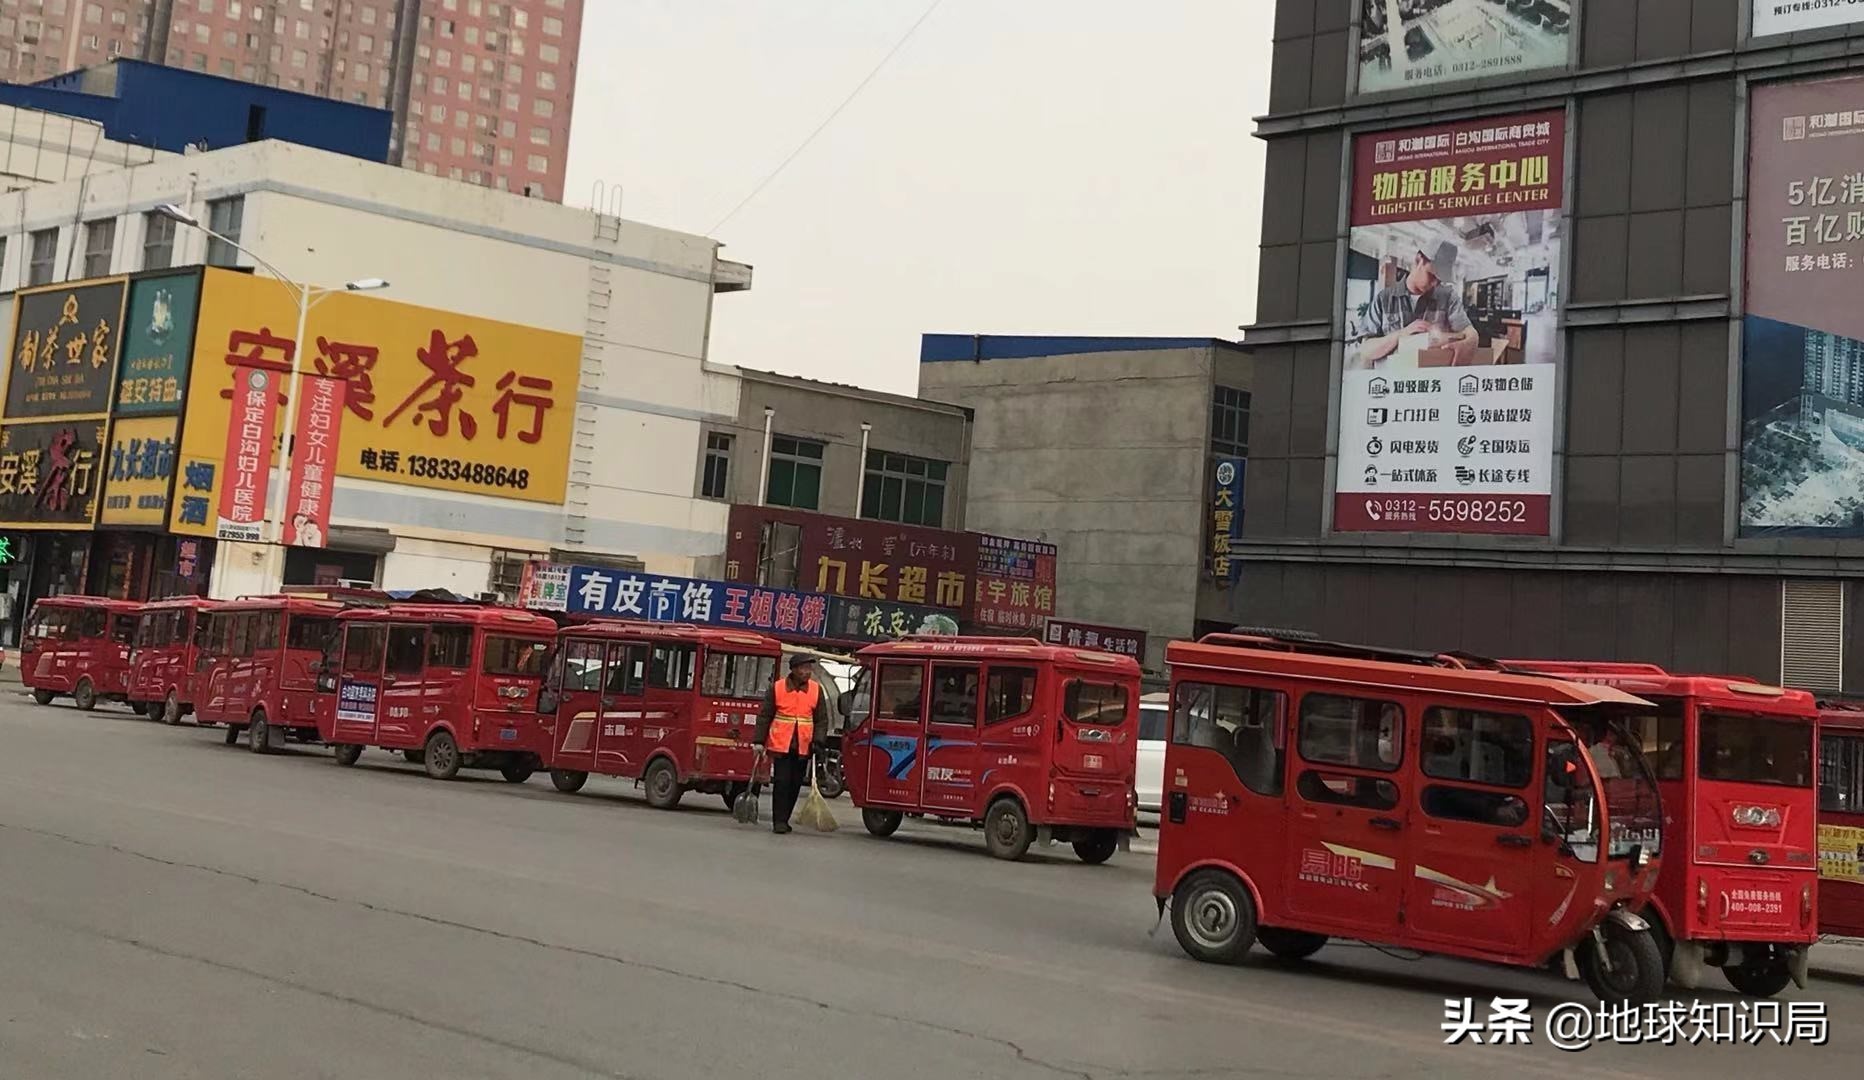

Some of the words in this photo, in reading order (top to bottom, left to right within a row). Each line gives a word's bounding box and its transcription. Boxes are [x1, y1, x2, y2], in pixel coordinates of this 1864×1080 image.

[1456, 121, 1551, 147] 白沟国际商贸城
[1372, 156, 1549, 200] 物流服务中心
[1371, 200, 1434, 216] LOGISTICS
[1439, 193, 1491, 209] SERVICE
[1496, 188, 1548, 204] CENTER
[1481, 377, 1534, 392] 货物仓储
[1392, 408, 1440, 422] 上门打包
[1480, 408, 1532, 422] 货站提货
[231, 389, 267, 522] 保定白沟妇儿医院
[298, 377, 336, 517] 专注妇女儿童健康
[1390, 439, 1439, 454] 闪电发货
[1479, 439, 1530, 454] 全国货运
[1380, 468, 1438, 482] 一站式体系
[1478, 469, 1530, 483] 长途专线
[178, 459, 215, 526] 烟酒
[720, 587, 826, 634] 王姐馅饼
